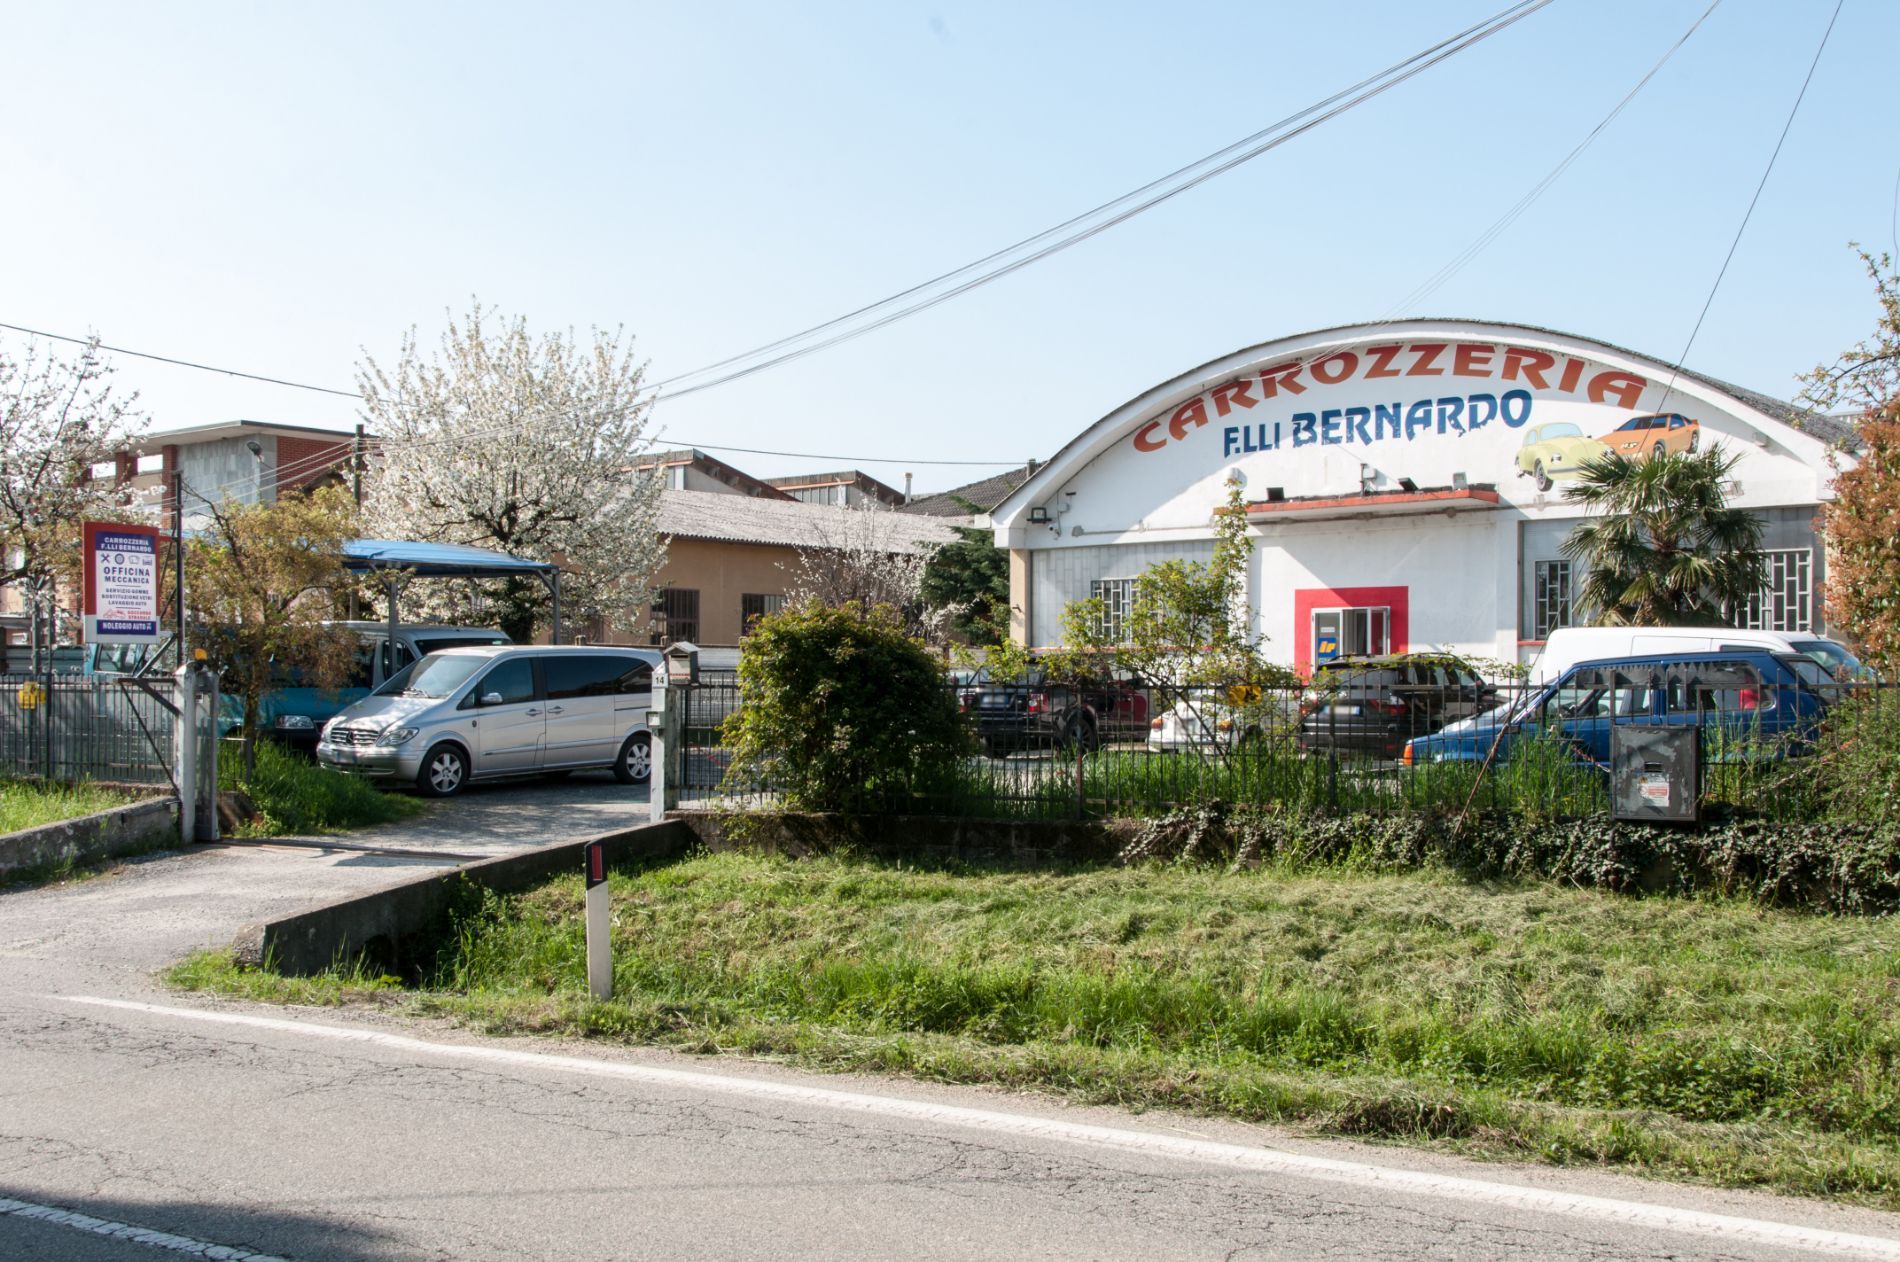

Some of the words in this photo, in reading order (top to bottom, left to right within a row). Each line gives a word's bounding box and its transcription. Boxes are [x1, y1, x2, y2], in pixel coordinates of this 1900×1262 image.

[1133, 343, 1648, 453] CARROZZERIA
[1223, 422, 1281, 458] F.LLI
[1292, 389, 1533, 448] BERNARDO
[104, 537, 149, 546] CARROZZERIA
[118, 544, 152, 553] BERNARDO
[104, 566, 150, 577] OFFICINA
[104, 576, 150, 584] MECCANICA
[102, 622, 132, 630] NOLEGGIO
[132, 623, 146, 631] AUTO
[655, 676, 665, 685] 14
